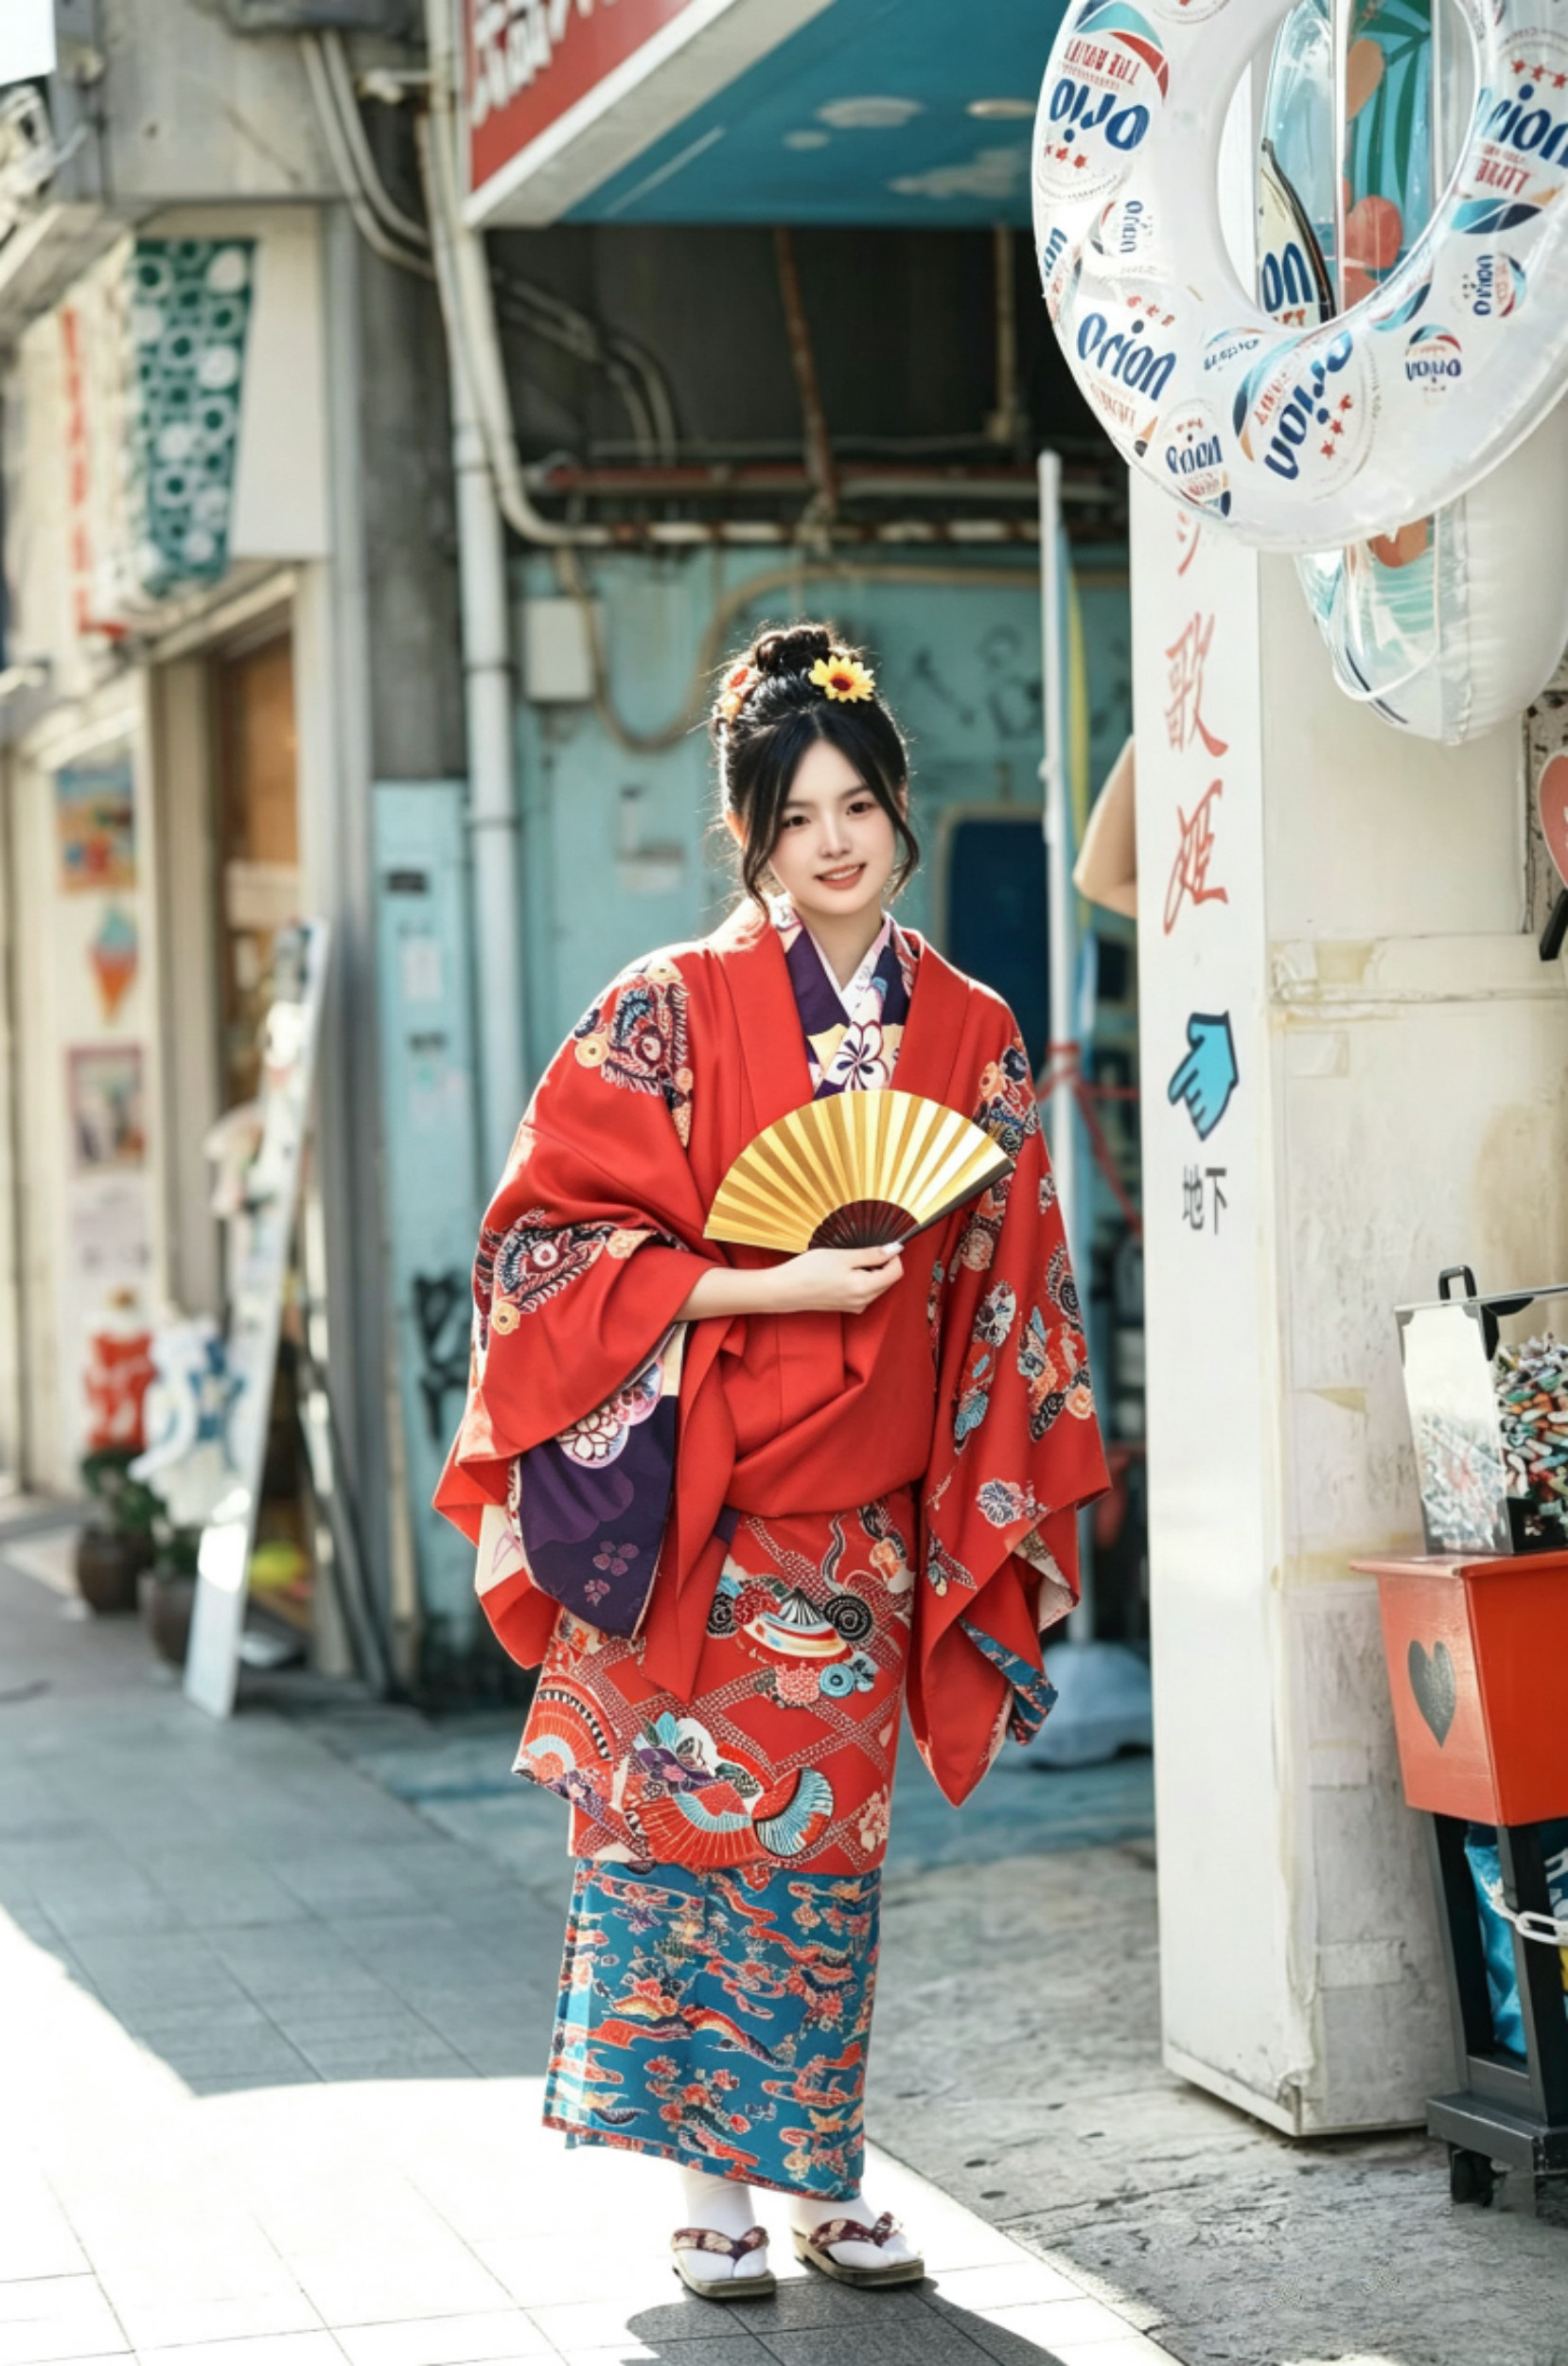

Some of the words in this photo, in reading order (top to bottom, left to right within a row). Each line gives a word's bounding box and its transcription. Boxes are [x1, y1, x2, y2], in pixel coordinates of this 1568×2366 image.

[1077, 312, 1177, 401] Orion
[1264, 328, 1353, 480] Orion
[1182, 1163, 1227, 1235] 地下
